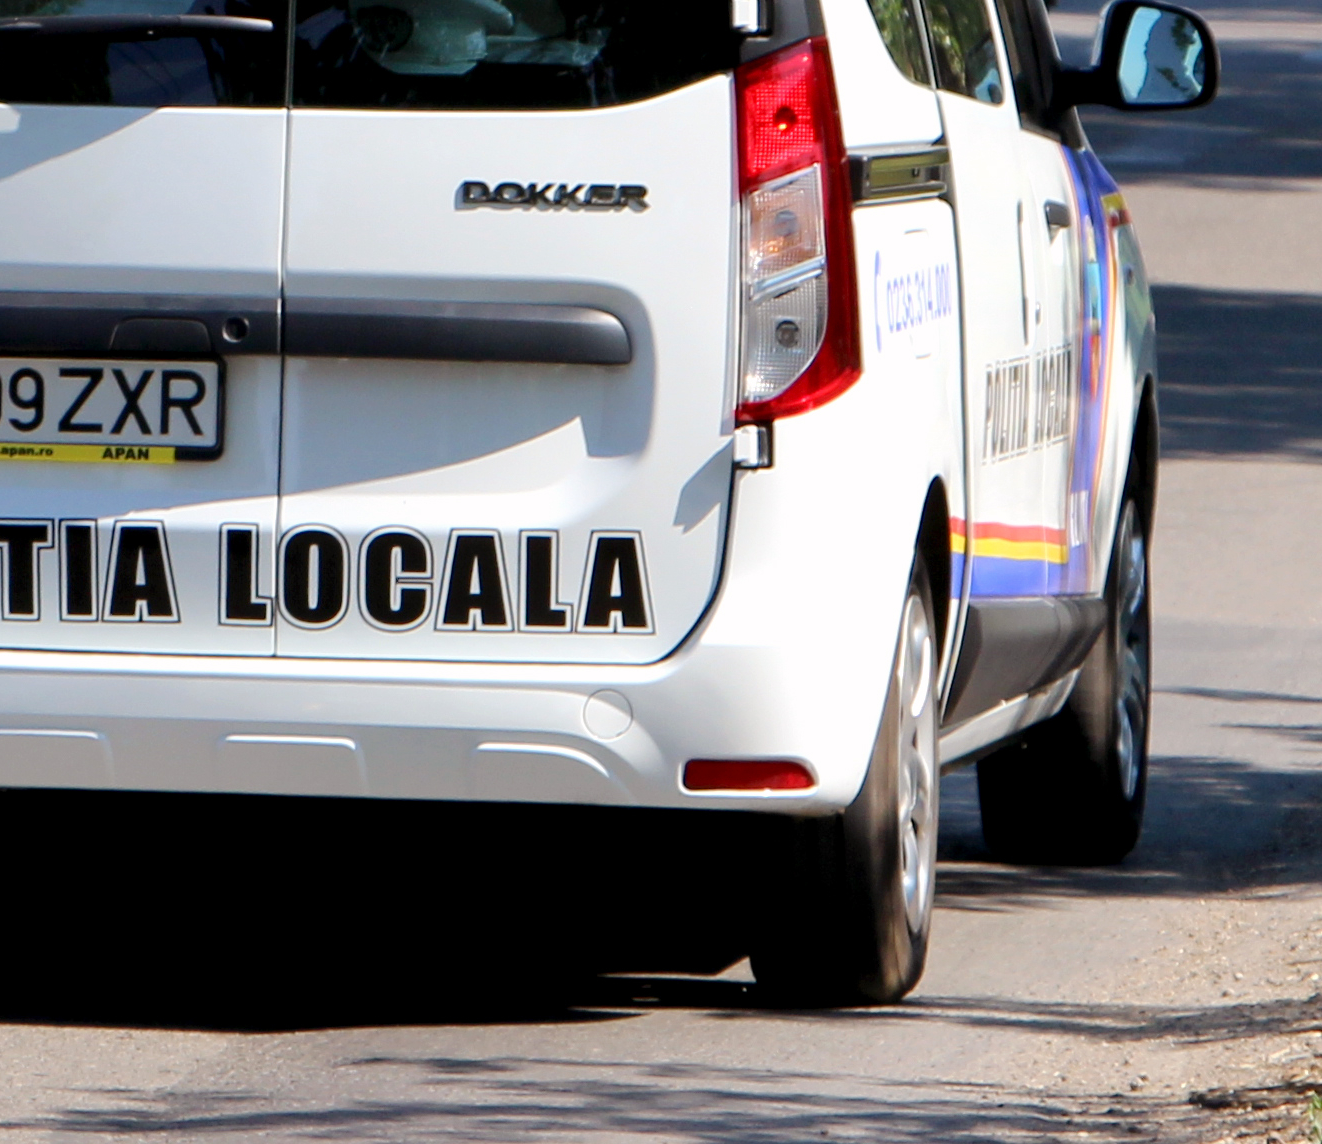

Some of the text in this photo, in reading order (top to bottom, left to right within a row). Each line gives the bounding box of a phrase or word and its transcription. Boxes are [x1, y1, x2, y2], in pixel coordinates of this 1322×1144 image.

[457, 181, 650, 211] DOKKER
[102, 446, 150, 461] APAN
[218, 522, 656, 635] LOCALA
